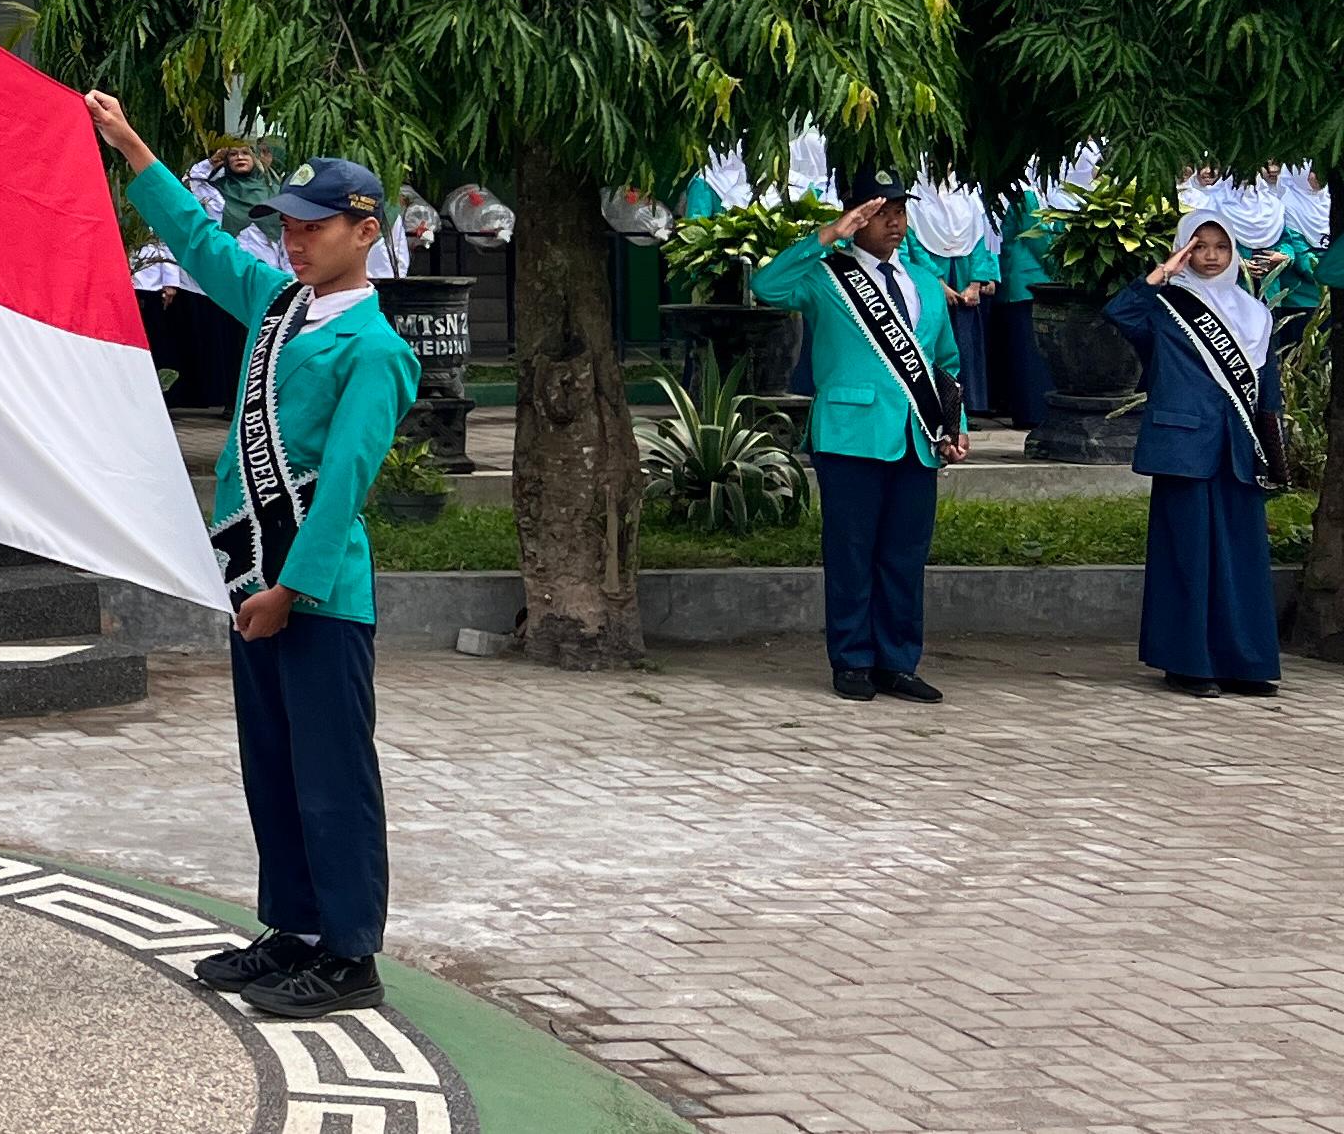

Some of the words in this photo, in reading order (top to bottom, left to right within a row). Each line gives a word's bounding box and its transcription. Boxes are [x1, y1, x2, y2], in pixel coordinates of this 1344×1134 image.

[246, 314, 284, 406] PENGIBAR
[843, 268, 888, 321] PEMBACA
[880, 318, 910, 352] TEKS
[899, 349, 923, 383] DO'A
[1193, 311, 1249, 381] PEMBAWA
[244, 407, 281, 508] BENDERA
